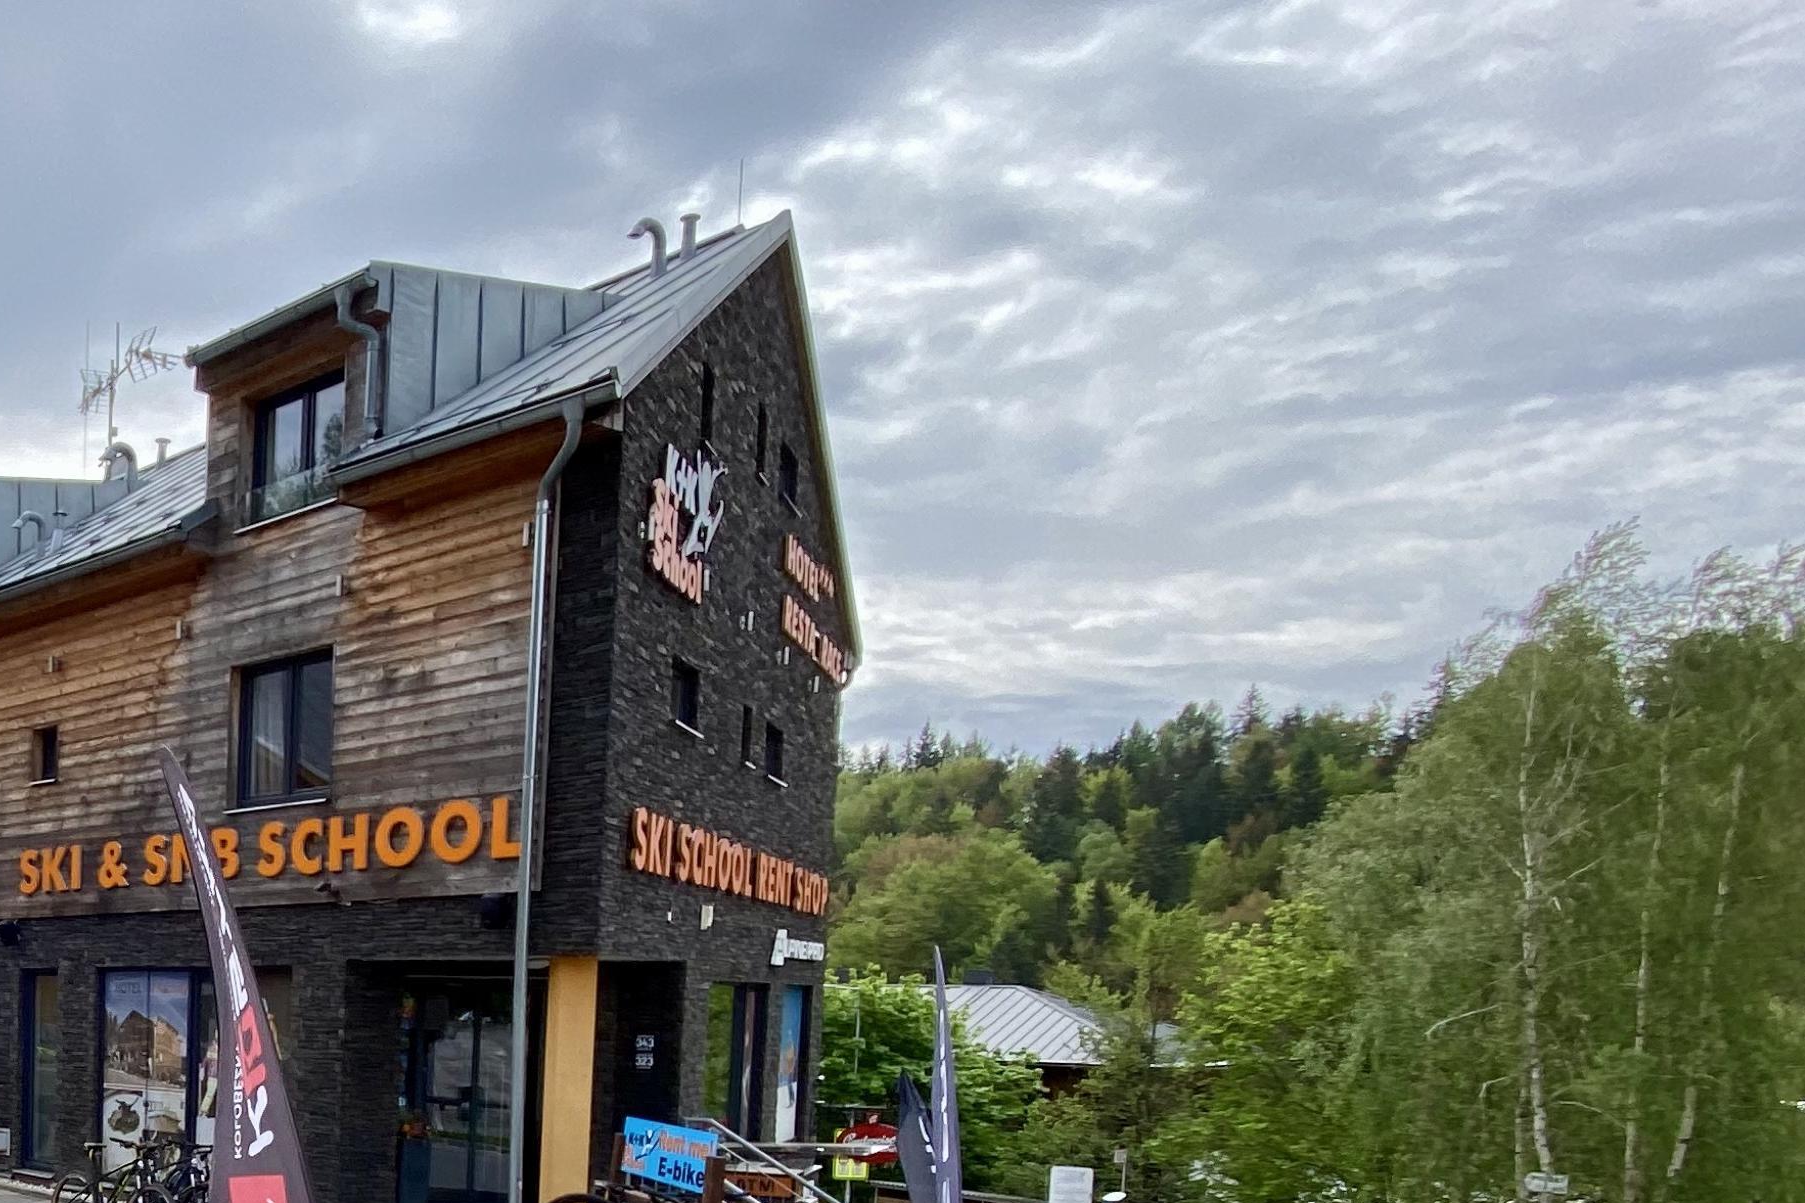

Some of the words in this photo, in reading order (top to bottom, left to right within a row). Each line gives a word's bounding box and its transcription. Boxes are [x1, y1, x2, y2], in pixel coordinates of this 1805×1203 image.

[652, 524, 702, 604] School
[784, 533, 819, 602] HOTEL
[19, 845, 82, 895] SKI
[98, 840, 129, 888] &
[257, 796, 522, 877] SCHOOL
[632, 807, 673, 877] SKI
[677, 823, 753, 897] SCHOOL
[757, 852, 795, 907] RENT
[796, 866, 829, 916] SHOP
[658, 1156, 705, 1188] E-bike
